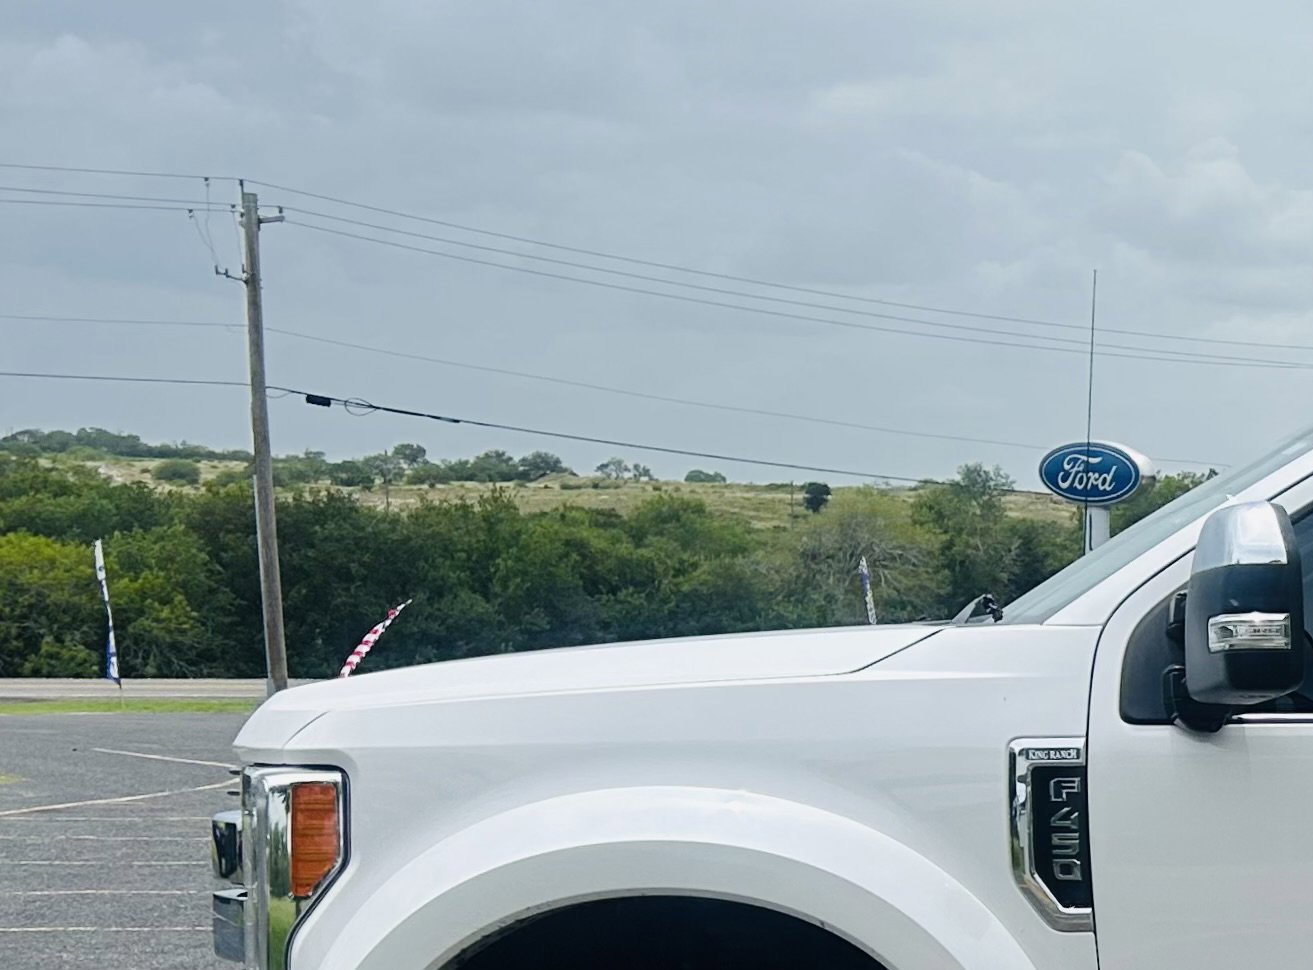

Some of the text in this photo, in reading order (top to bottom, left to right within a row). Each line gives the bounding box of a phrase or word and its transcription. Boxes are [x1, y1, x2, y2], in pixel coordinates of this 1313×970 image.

[1057, 454, 1117, 491] Ford
[1028, 748, 1078, 760] KING RANCH
